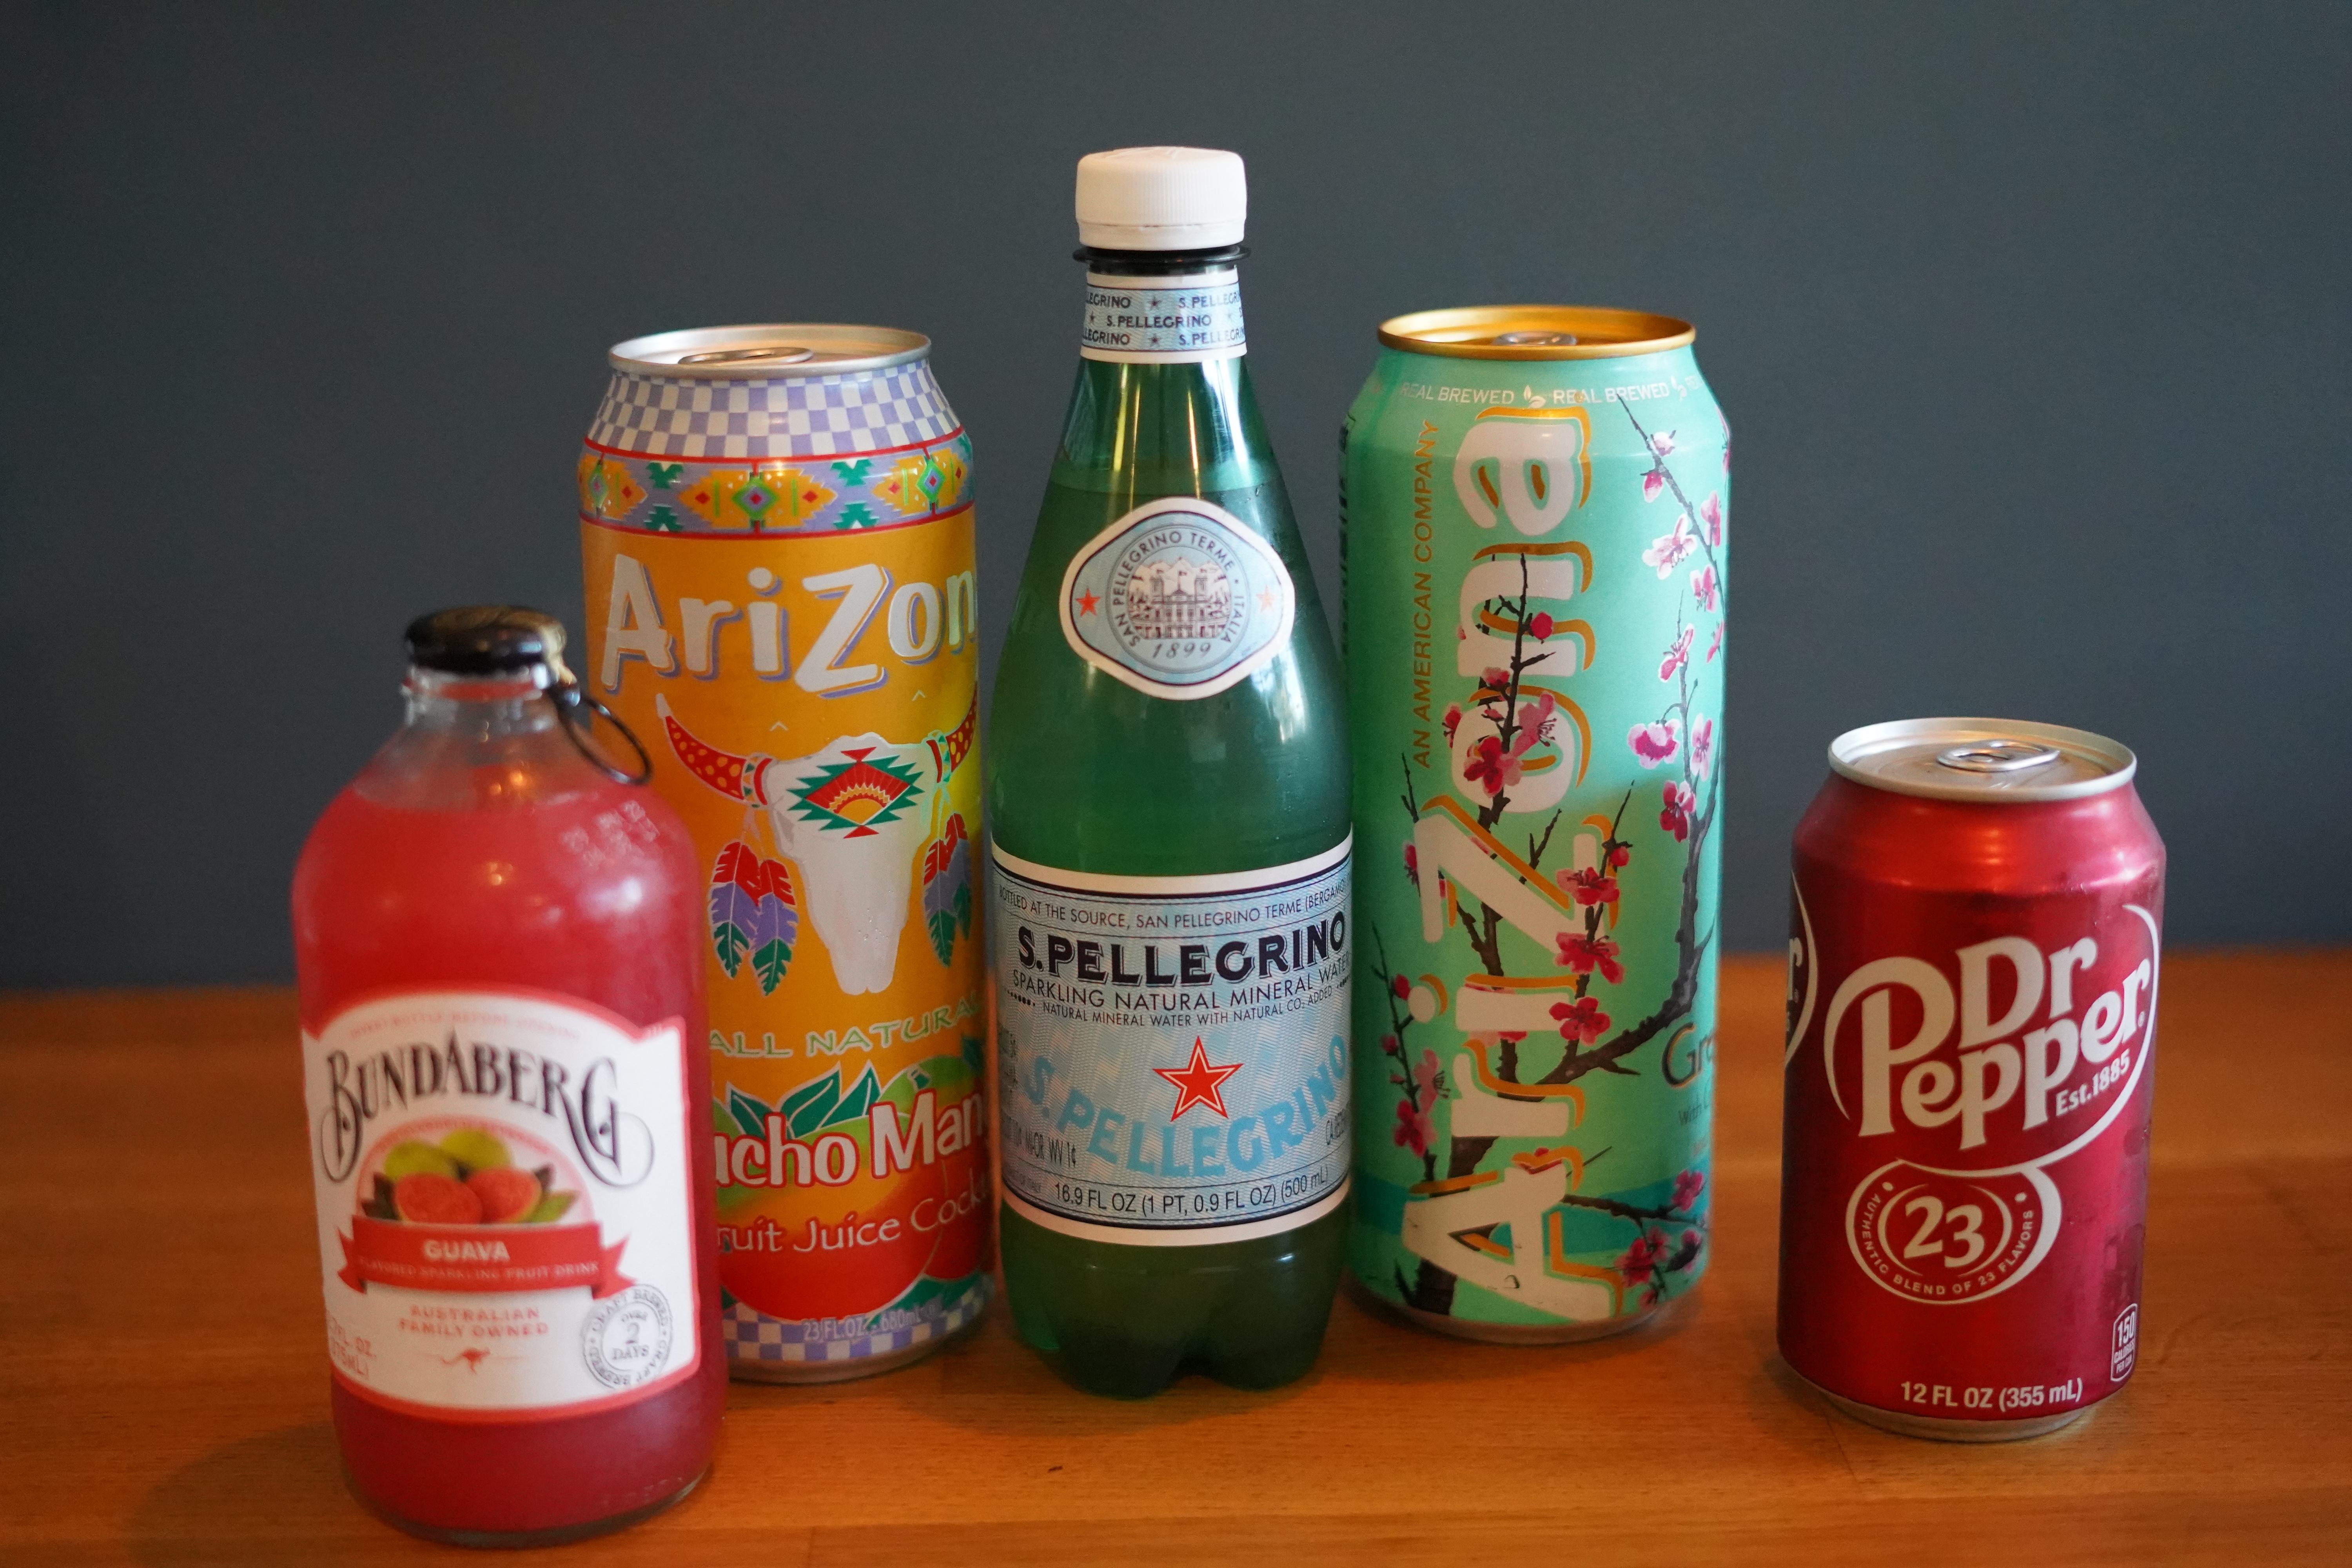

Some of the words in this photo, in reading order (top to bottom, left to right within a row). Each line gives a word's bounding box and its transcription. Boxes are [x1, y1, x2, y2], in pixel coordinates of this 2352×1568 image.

[1438, 387, 1514, 404] BREWED
[1553, 388, 1602, 404] REAL
[1604, 382, 1670, 403] BREWED
[1413, 419, 1439, 563] COMPANY
[1112, 531, 1182, 606] PELLEGRINO
[1189, 532, 1236, 570] TERME
[1115, 612, 1142, 648] SAN
[1220, 595, 1245, 643] ITALIA
[1152, 642, 1212, 659] 1899
[1413, 570, 1432, 723] AMERICAN
[1413, 730, 1431, 768] AN
[1401, 407, 1624, 1320] AriZona
[1031, 902, 1042, 915] AT
[1045, 903, 1065, 920] THE
[1071, 908, 1130, 929] SOURCE,
[1137, 914, 1168, 928] SAN
[1174, 908, 1260, 928] PELLEGRINO
[1265, 899, 1301, 918] TERME
[1018, 911, 1347, 987] S.PELLEGRINO
[1013, 969, 1105, 1007] SPARKLING
[1115, 991, 1220, 1011] NATURAL
[1230, 973, 1313, 1006] MINERAL
[1043, 1000, 1088, 1022] NATURAL
[1092, 1011, 1145, 1027] MINERAL
[1150, 1014, 1191, 1026] WATER
[1197, 1012, 1228, 1025] WITH
[1234, 1002, 1283, 1022] NATURAL
[1308, 985, 1332, 1006] ADDED
[1955, 936, 2098, 1051] Dr
[709, 1029, 793, 1058] ALL
[1824, 956, 2151, 1151] Pepper
[1024, 1034, 1347, 1177] S.PELLEGRINO
[1054, 1181, 1083, 1205] 16.9
[1088, 1189, 1107, 1210] FL
[1112, 1192, 1136, 1212] OZ
[1142, 1194, 1154, 1217] (1
[1163, 1194, 1187, 1216] PT,
[1194, 1194, 1219, 1212] 0.9
[1225, 1190, 1245, 1210] FL
[1250, 1183, 1276, 1206] OZ)
[1281, 1174, 1307, 1203] (500
[423, 1240, 510, 1261] GUAVA
[793, 1214, 901, 1252] Juice
[1862, 1193, 1889, 1274] AUTHENTIC
[1893, 1274, 1946, 1294] BLEND
[1952, 1280, 1973, 1294] OF
[1977, 1272, 1996, 1286] 23
[1997, 1209, 2034, 1273] FLAVORS
[1903, 1196, 1985, 1268] 23
[507, 1265, 548, 1279] FRUIT
[554, 1261, 599, 1277] DRINK
[399, 1318, 465, 1338] FAMILY
[472, 1322, 548, 1338] OWNED
[410, 1304, 539, 1322] AUSTRALIAN
[803, 1321, 819, 1340] 23
[2118, 1311, 2135, 1348] 150
[626, 1321, 641, 1344] 2
[612, 1345, 649, 1361] DAYS
[1901, 1381, 1927, 1404] 12
[1932, 1384, 1958, 1407] FL
[1964, 1387, 1994, 1408] OZ
[1999, 1385, 2045, 1412] (355
[2049, 1377, 2083, 1403] mL)
